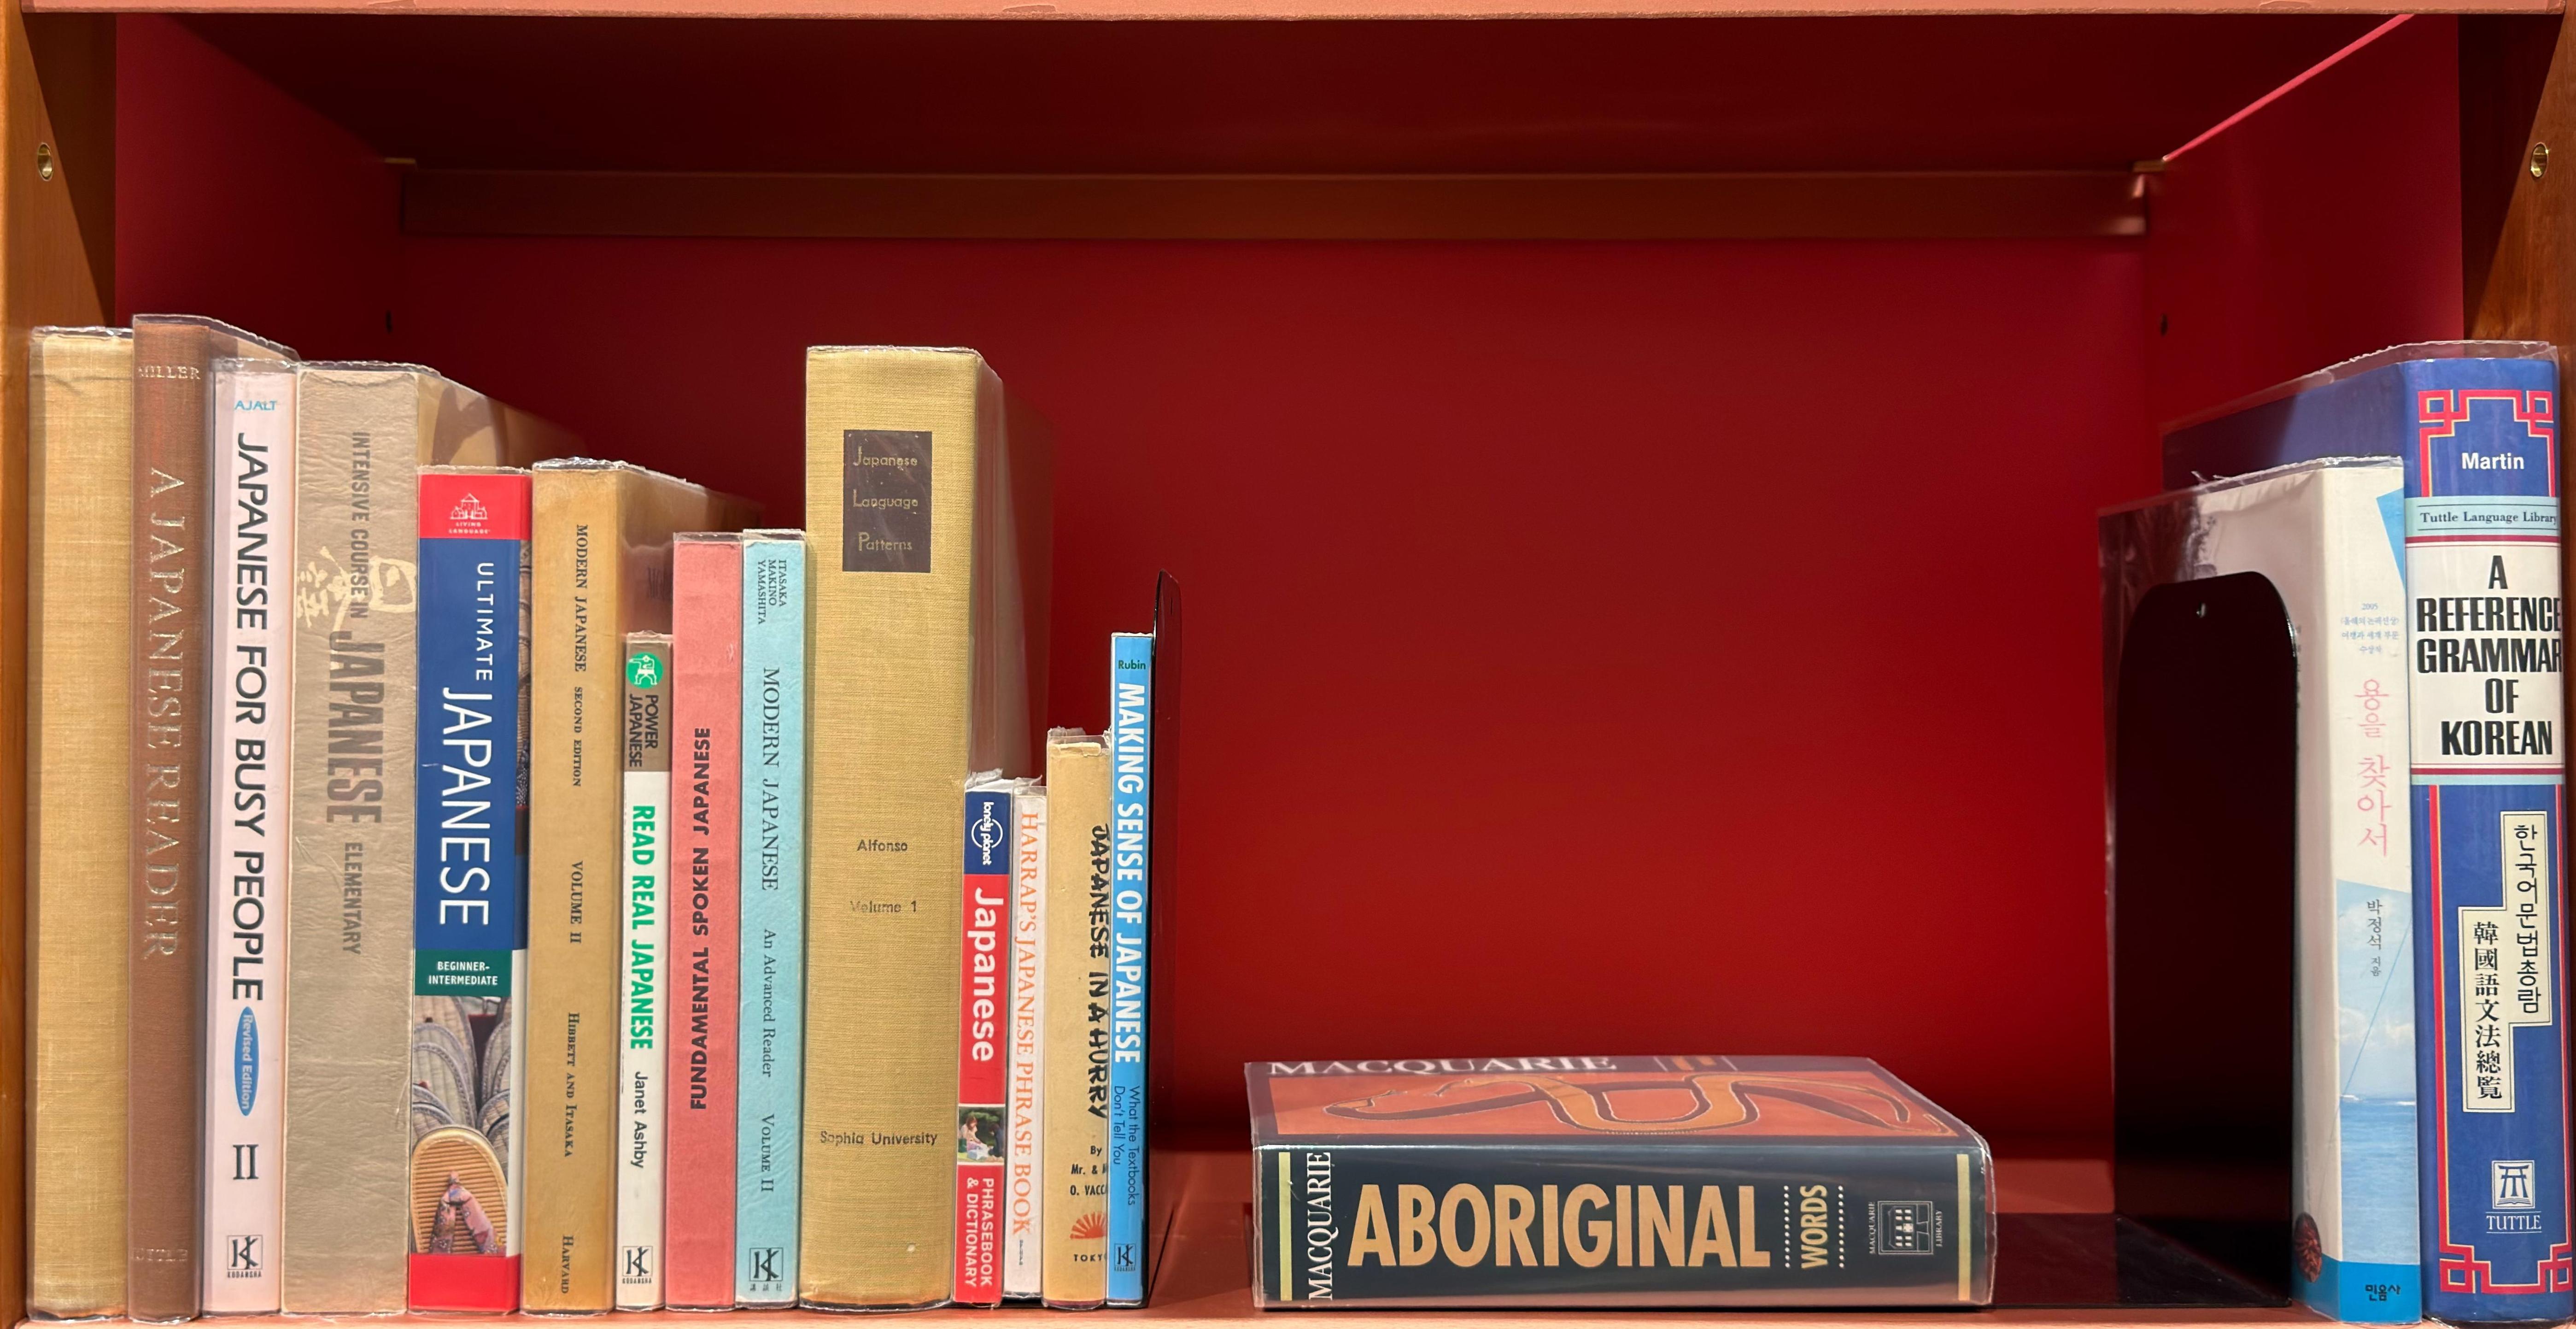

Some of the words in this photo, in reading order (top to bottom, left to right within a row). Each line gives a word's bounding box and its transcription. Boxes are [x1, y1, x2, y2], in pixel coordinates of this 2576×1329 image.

[139, 367, 200, 380] MILLER
[234, 400, 277, 411] AJALT
[352, 432, 370, 522] INTENSIVE
[854, 446, 918, 467] Japanese
[2462, 453, 2524, 470] Martin
[151, 467, 184, 497] A
[853, 489, 918, 510] Language
[236, 433, 269, 630] JAPANESE
[858, 532, 912, 551] Patterns
[2420, 512, 2458, 523] Tuttle
[2464, 513, 2518, 524] Language
[351, 529, 369, 596] COURSE
[576, 524, 588, 588] MODERN
[2488, 555, 2508, 589] A
[757, 559, 767, 624] YAMASHITA
[768, 559, 777, 606] MAKINO
[778, 560, 787, 607] ITASAKA
[147, 512, 185, 748] JAPANESE
[350, 601, 368, 618] IN
[476, 563, 494, 680] ULTIMATE
[2417, 597, 2561, 632] REFERENCE
[575, 597, 587, 672] JAPANESE
[2417, 638, 2562, 674] GRAMMAR
[235, 646, 267, 724] FOR
[1118, 659, 1146, 670] Rubin
[763, 667, 780, 767] MODERN
[2355, 679, 2389, 738] 용을
[2485, 678, 2518, 714] OF
[327, 631, 385, 823] JAPANESE
[629, 694, 643, 767] JAPANESE
[645, 694, 659, 748] POWER
[1118, 682, 1145, 794] MAKING
[2441, 721, 2552, 755] KOREAN
[573, 740, 581, 786] EDITION
[693, 727, 710, 835] JAPANESE
[234, 739, 266, 837] BUSY
[440, 688, 492, 925] JAPANESE
[2357, 754, 2391, 857] 찾아서
[632, 806, 656, 865] READ
[762, 779, 779, 891] JAPANESE
[980, 802, 994, 831] lonely
[144, 764, 181, 959] READER
[857, 839, 908, 852] Alfonso
[981, 833, 993, 865] planet
[1117, 803, 1144, 881] SENSE
[342, 842, 363, 955] ELEMENTARY
[570, 861, 583, 924] VOLUME
[632, 875, 655, 930] REAL
[692, 847, 709, 936] SPOKEN
[849, 901, 901, 913] Volume
[911, 901, 917, 912] 1
[1089, 824, 1110, 958] JAPANESE
[1117, 890, 1143, 924] OF
[232, 851, 264, 1001] PEOPLE
[570, 932, 581, 944] II
[764, 929, 776, 949] An
[2366, 900, 2383, 951] 박정석
[428, 976, 498, 985] INTERMEDIATE
[438, 962, 490, 970] BEGINNER-
[763, 954, 776, 1023] Advanced
[968, 888, 1004, 1061] Japanese
[1089, 972, 1109, 997] IN
[2371, 957, 2381, 976] 지음
[631, 940, 654, 1049] JAPANESE
[1016, 937, 1035, 1055] JAPANESE
[1088, 1003, 1107, 1022] A
[1115, 933, 1142, 1063] JAPANESE
[2473, 922, 2502, 1099] 韓國語文法總覽
[243, 1013, 253, 1061] Revised
[690, 947, 709, 1109] FUNDAMENTAL
[762, 1028, 776, 1078] Reader
[1088, 1029, 1109, 1118] HURRY
[1268, 1057, 1616, 1074] MACQUARIE
[242, 1065, 252, 1109] Edition
[566, 1073, 574, 1098] AND
[635, 1071, 648, 1114] Janet
[1014, 1061, 1033, 1155] PHRASE
[1113, 1086, 1125, 1116] Don't
[1128, 1085, 1140, 1119] What
[565, 1105, 577, 1157] ITASAKA
[631, 1120, 648, 1169] Ashby
[761, 1113, 775, 1172] VOLUME
[820, 1130, 864, 1146] Sophia
[872, 1132, 937, 1146] University
[1090, 1146, 1102, 1156] By
[1113, 1119, 1125, 1141] Tell
[1113, 1143, 1124, 1164] You
[1128, 1123, 1140, 1142] the
[233, 1144, 259, 1180] II
[761, 1179, 774, 1192] II
[967, 1178, 979, 1188] &
[1071, 1164, 1085, 1175] Mr.
[1092, 1165, 1098, 1174] &
[1128, 1145, 1140, 1206] Textbooks
[1013, 1164, 1032, 1236] BOOK
[1084, 1185, 1107, 1195] VACC
[966, 1194, 977, 1287] DICTIONARY
[981, 1178, 994, 1287] PHRASEBOOK
[1306, 1152, 1338, 1300] MACQUARIE
[1347, 1183, 1770, 1267] ABORIGINAL
[1801, 1184, 1828, 1270] WORDS
[2486, 1215, 2542, 1230] TUTTLE
[2365, 1284, 2400, 1301] 민음사
